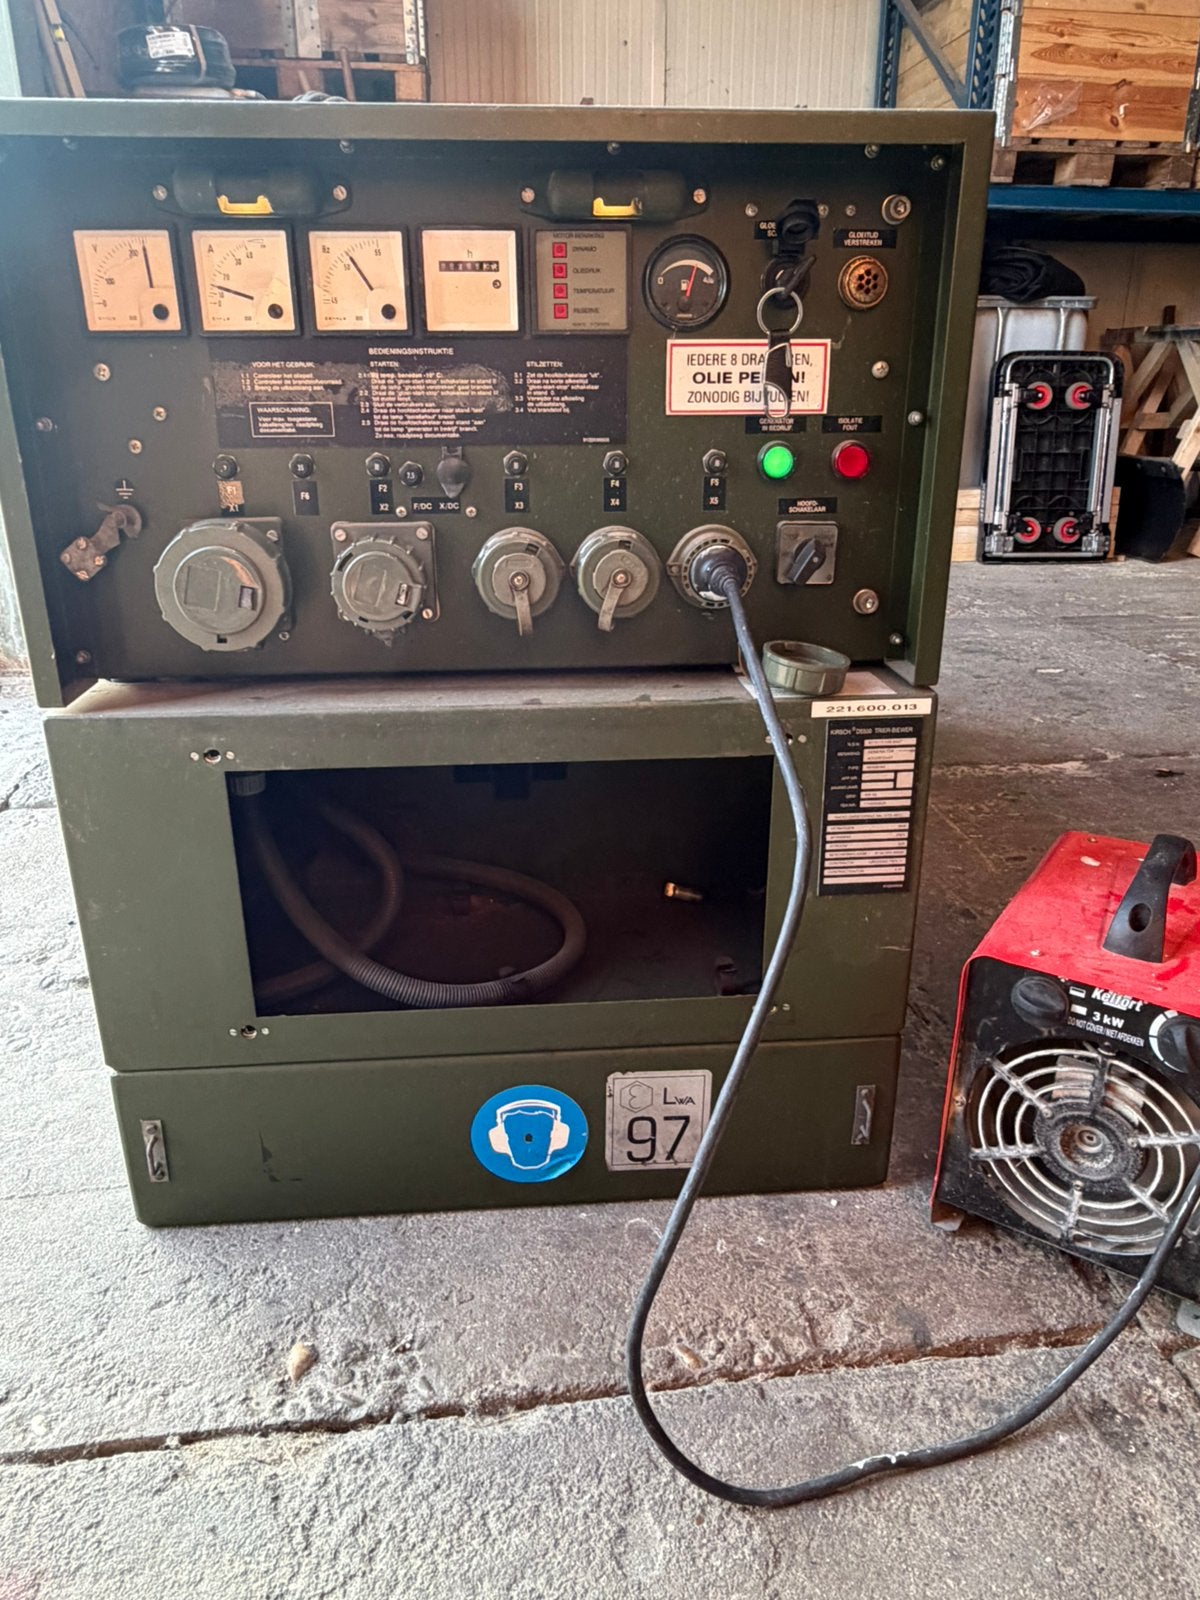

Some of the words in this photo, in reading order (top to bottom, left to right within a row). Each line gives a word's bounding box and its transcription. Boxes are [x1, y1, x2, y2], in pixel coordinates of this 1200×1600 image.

[843, 239, 883, 247] VERSTREKEN
[207, 244, 215, 254] A
[686, 353, 727, 366] IEDERE
[730, 354, 737, 366] 8
[692, 371, 733, 384] OLIE
[687, 391, 740, 403] ZONODIG
[514, 482, 524, 491] F3
[610, 479, 620, 488] F4
[710, 478, 720, 487] F5
[378, 484, 388, 492] F2
[610, 498, 620, 506] X4
[709, 496, 719, 505] X5
[379, 503, 389, 511] X2
[413, 502, 433, 510] F/DC
[439, 502, 459, 510] X/DC
[514, 501, 524, 510] X3
[826, 703, 918, 713] 221.600.013
[1091, 987, 1143, 1012] Kelfort
[1075, 1019, 1087, 1029] NOT
[1092, 1011, 1101, 1021] 3
[1102, 1014, 1125, 1029] kW
[626, 1115, 691, 1162] 97
